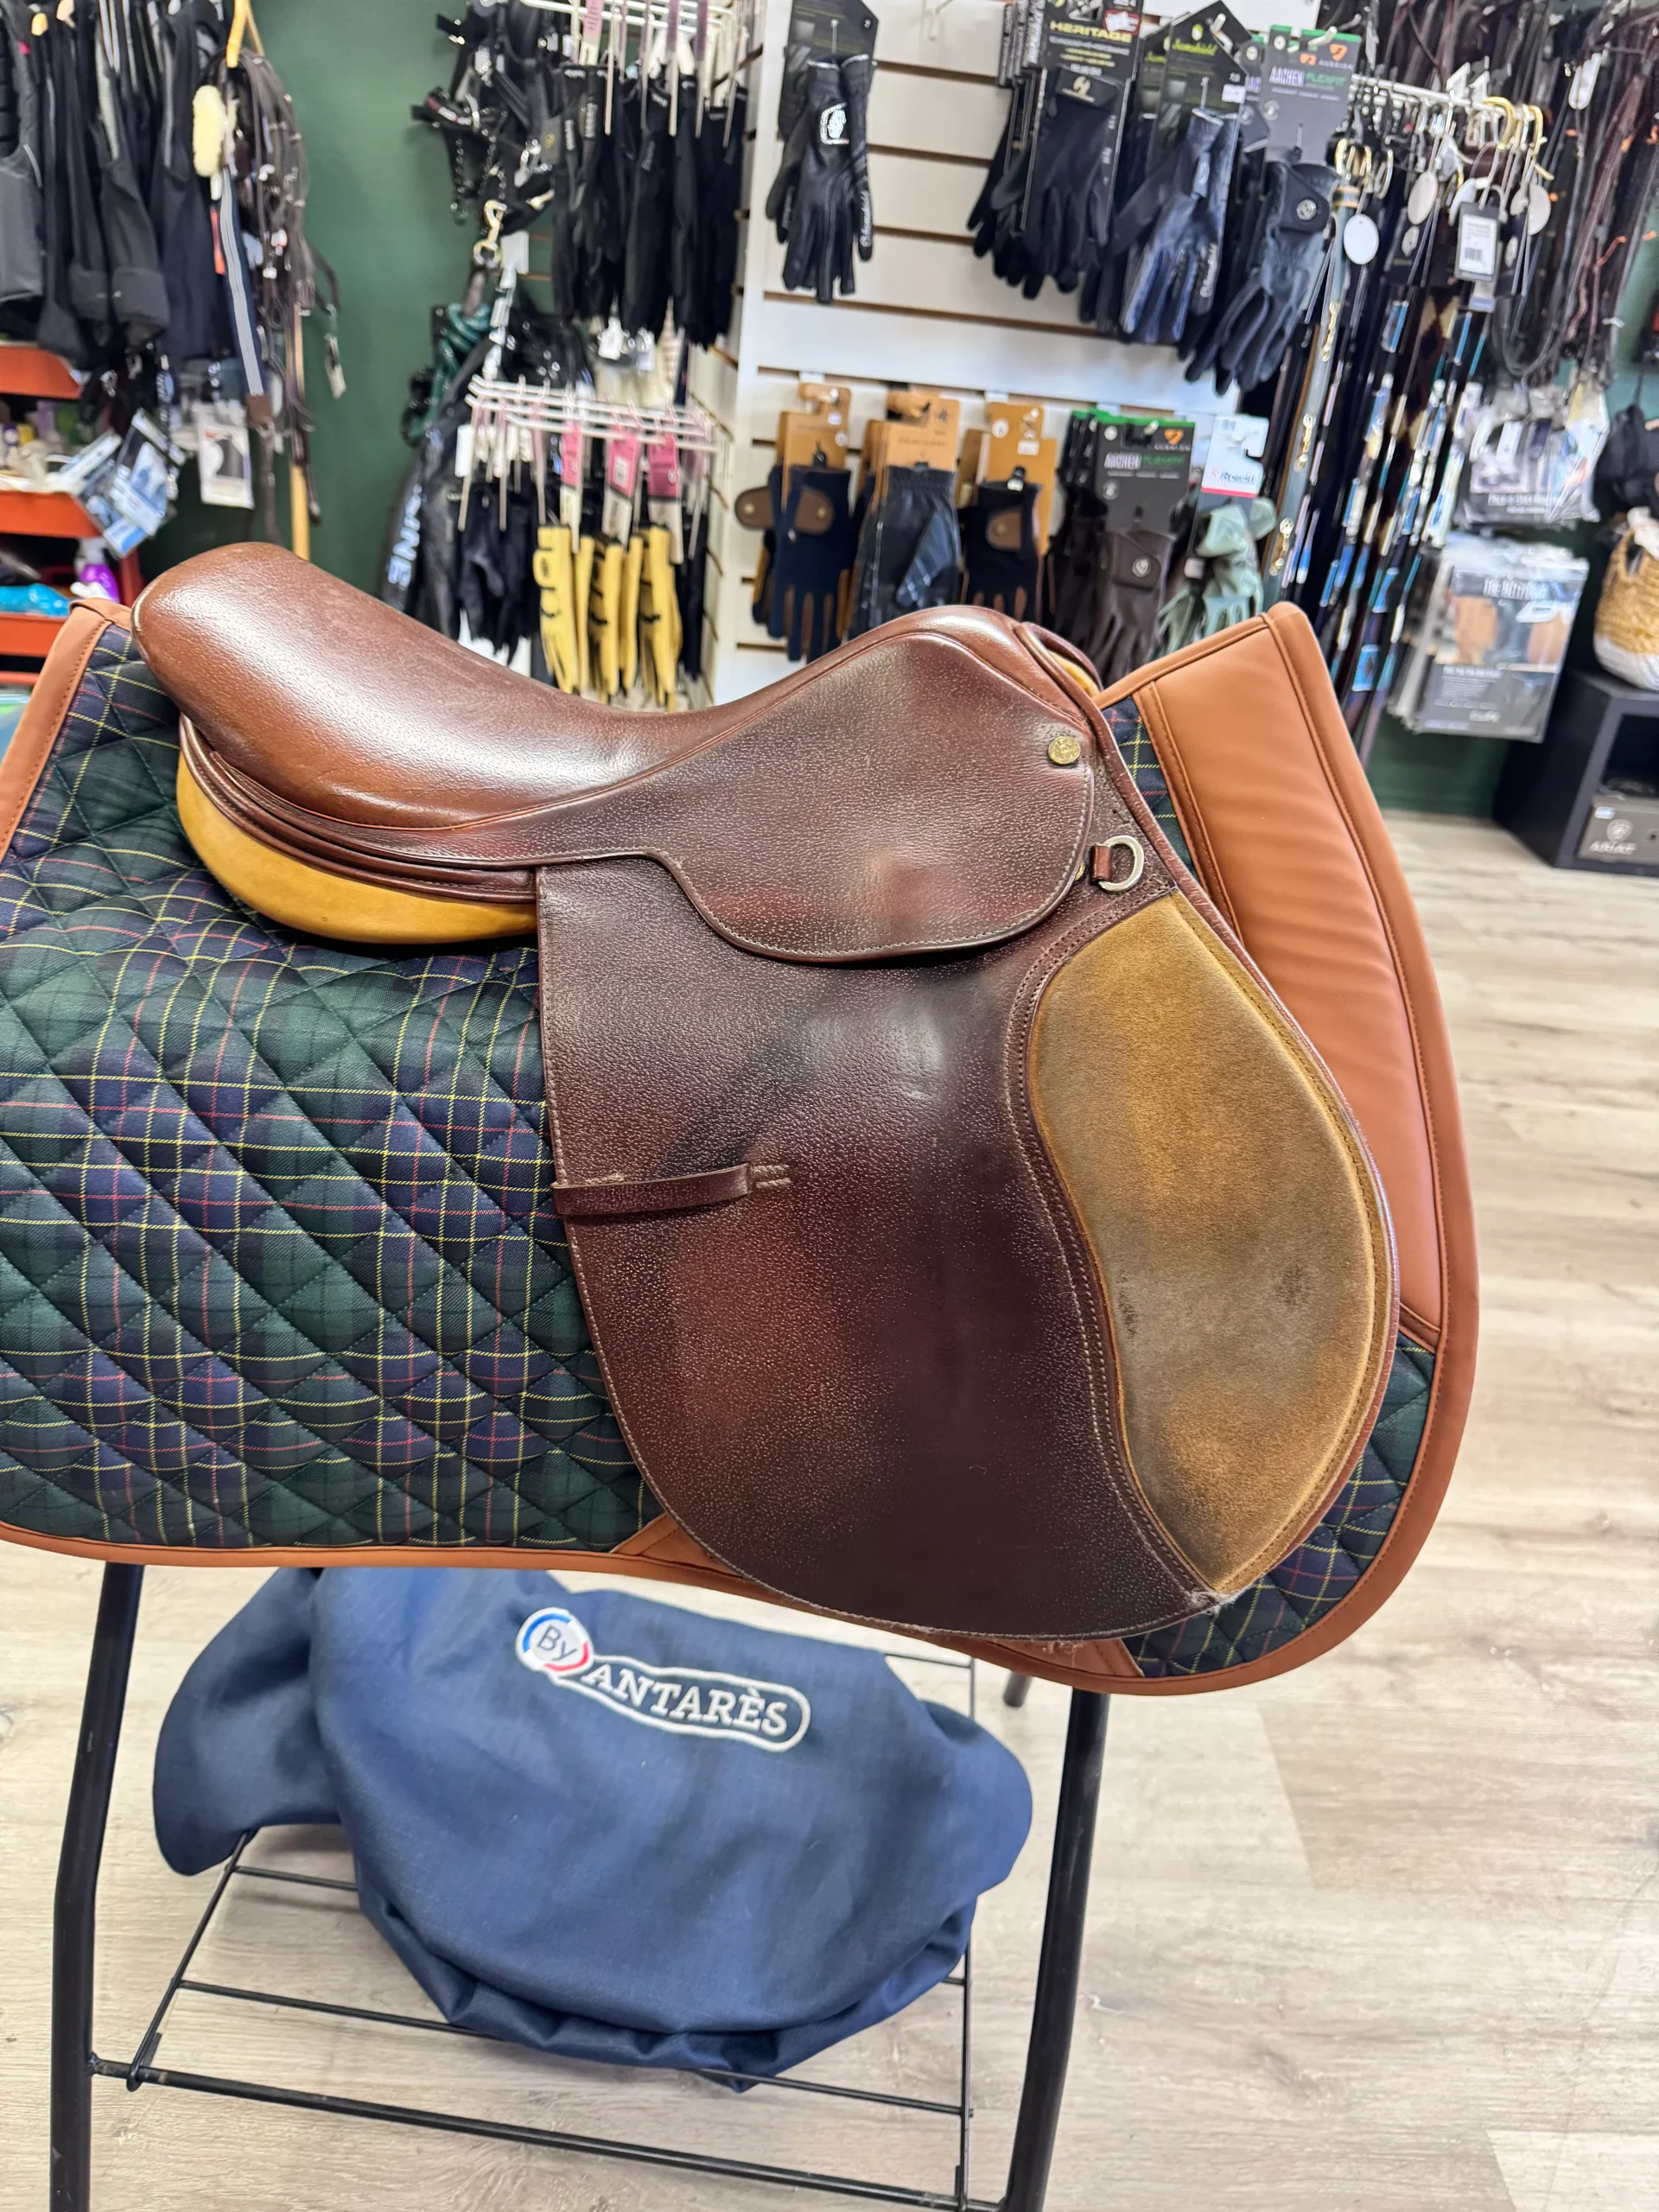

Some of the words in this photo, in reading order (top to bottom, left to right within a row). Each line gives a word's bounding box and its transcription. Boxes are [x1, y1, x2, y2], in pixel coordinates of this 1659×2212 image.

[1049, 21, 1133, 43] HERITAGE
[536, 1624, 579, 1662] By
[581, 1662, 790, 1736] ANTARÈS
